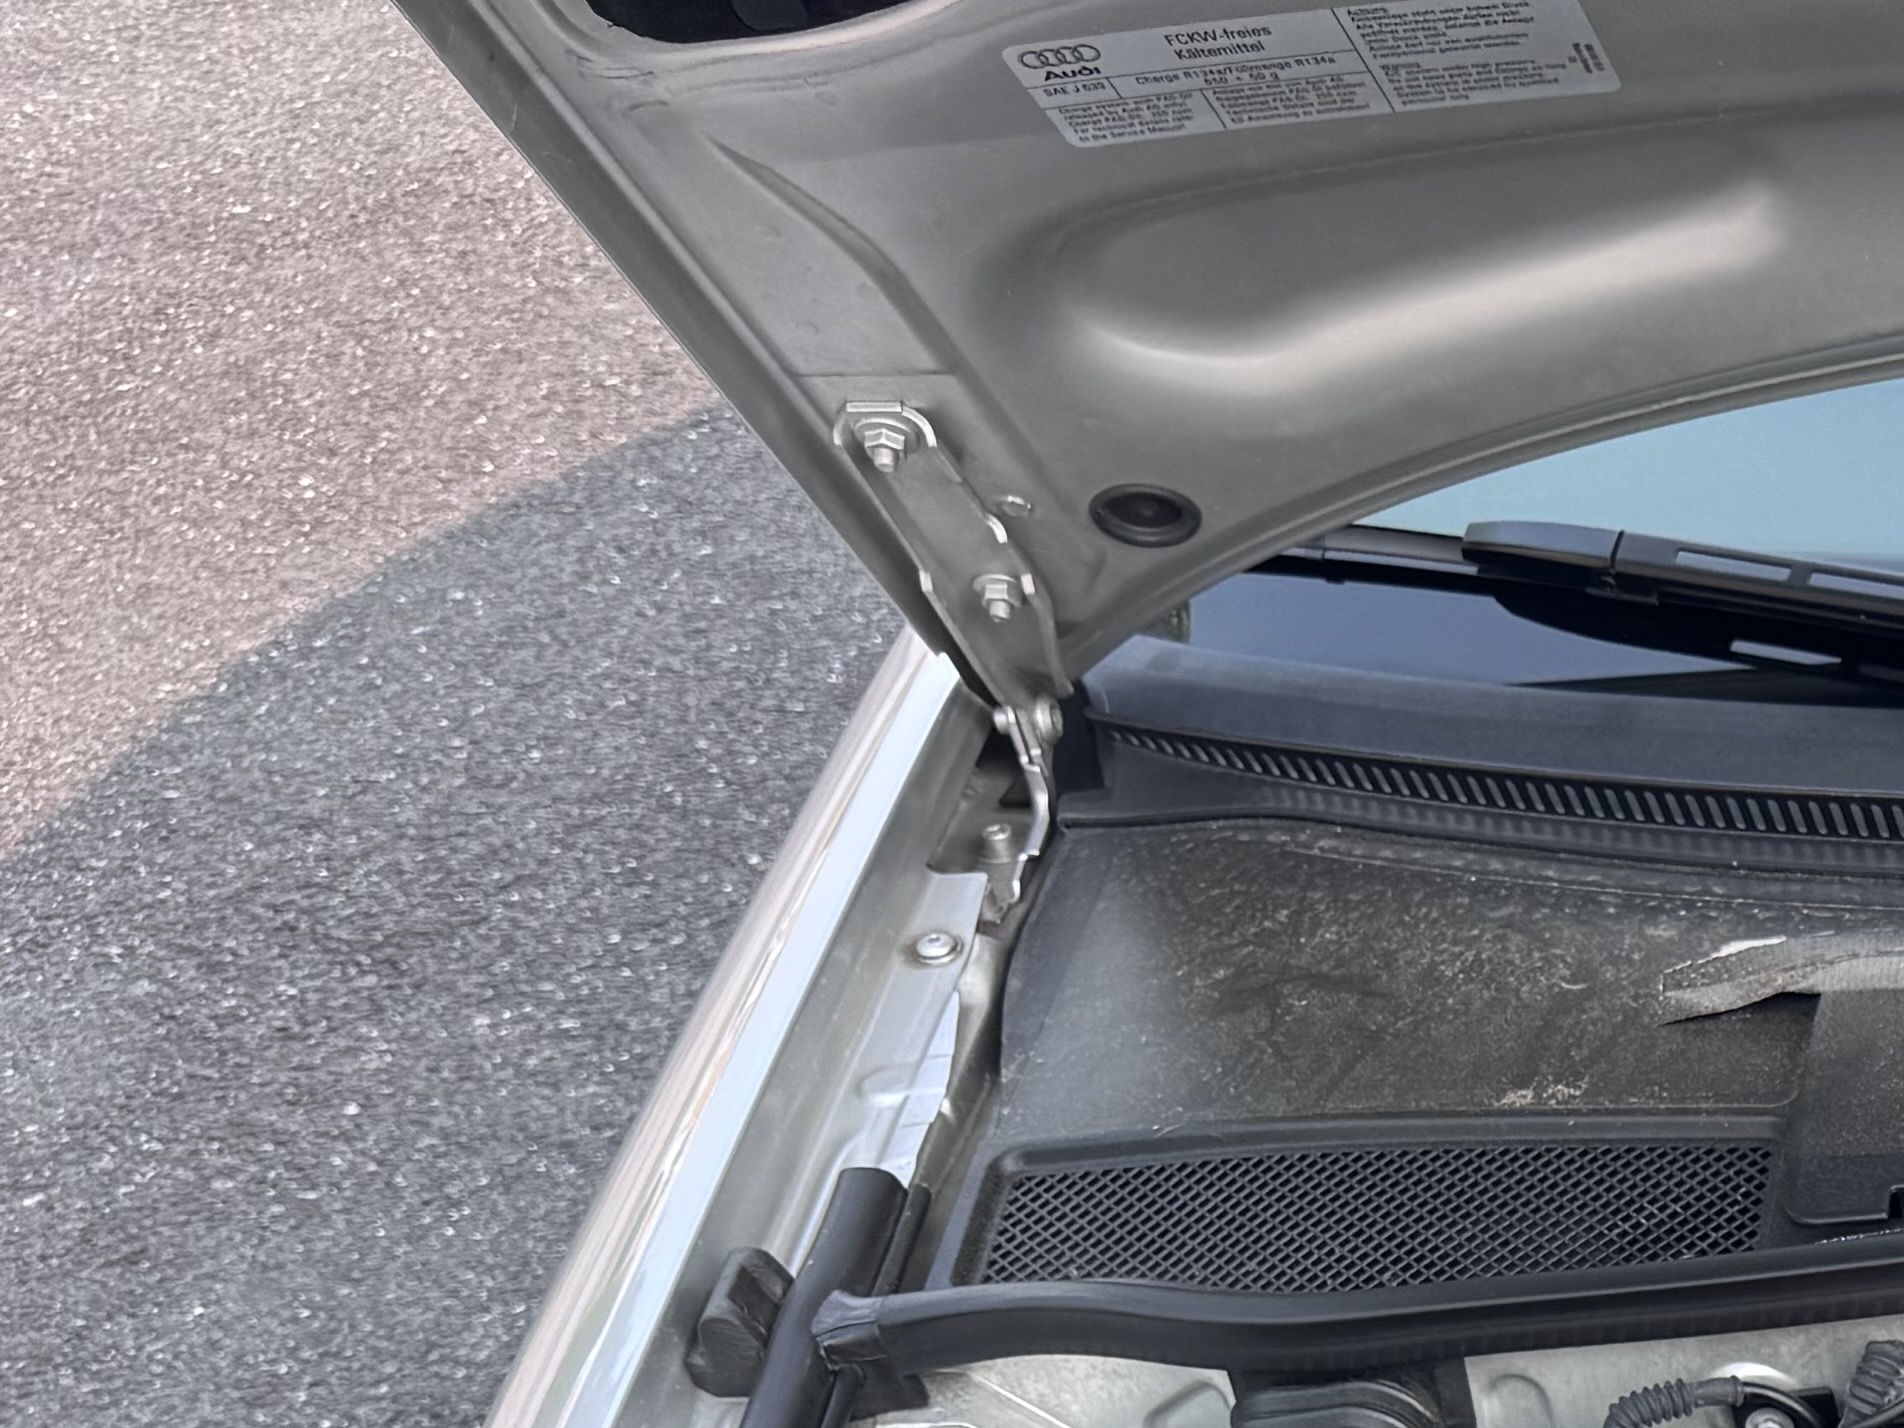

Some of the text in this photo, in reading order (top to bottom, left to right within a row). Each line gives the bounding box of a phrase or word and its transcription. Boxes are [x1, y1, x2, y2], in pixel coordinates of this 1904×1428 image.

[1164, 25, 1272, 46] FCKW-freies
[1174, 40, 1265, 60] Kältemittel
[1043, 67, 1101, 82] Audi
[1042, 87, 1068, 99] SAE
